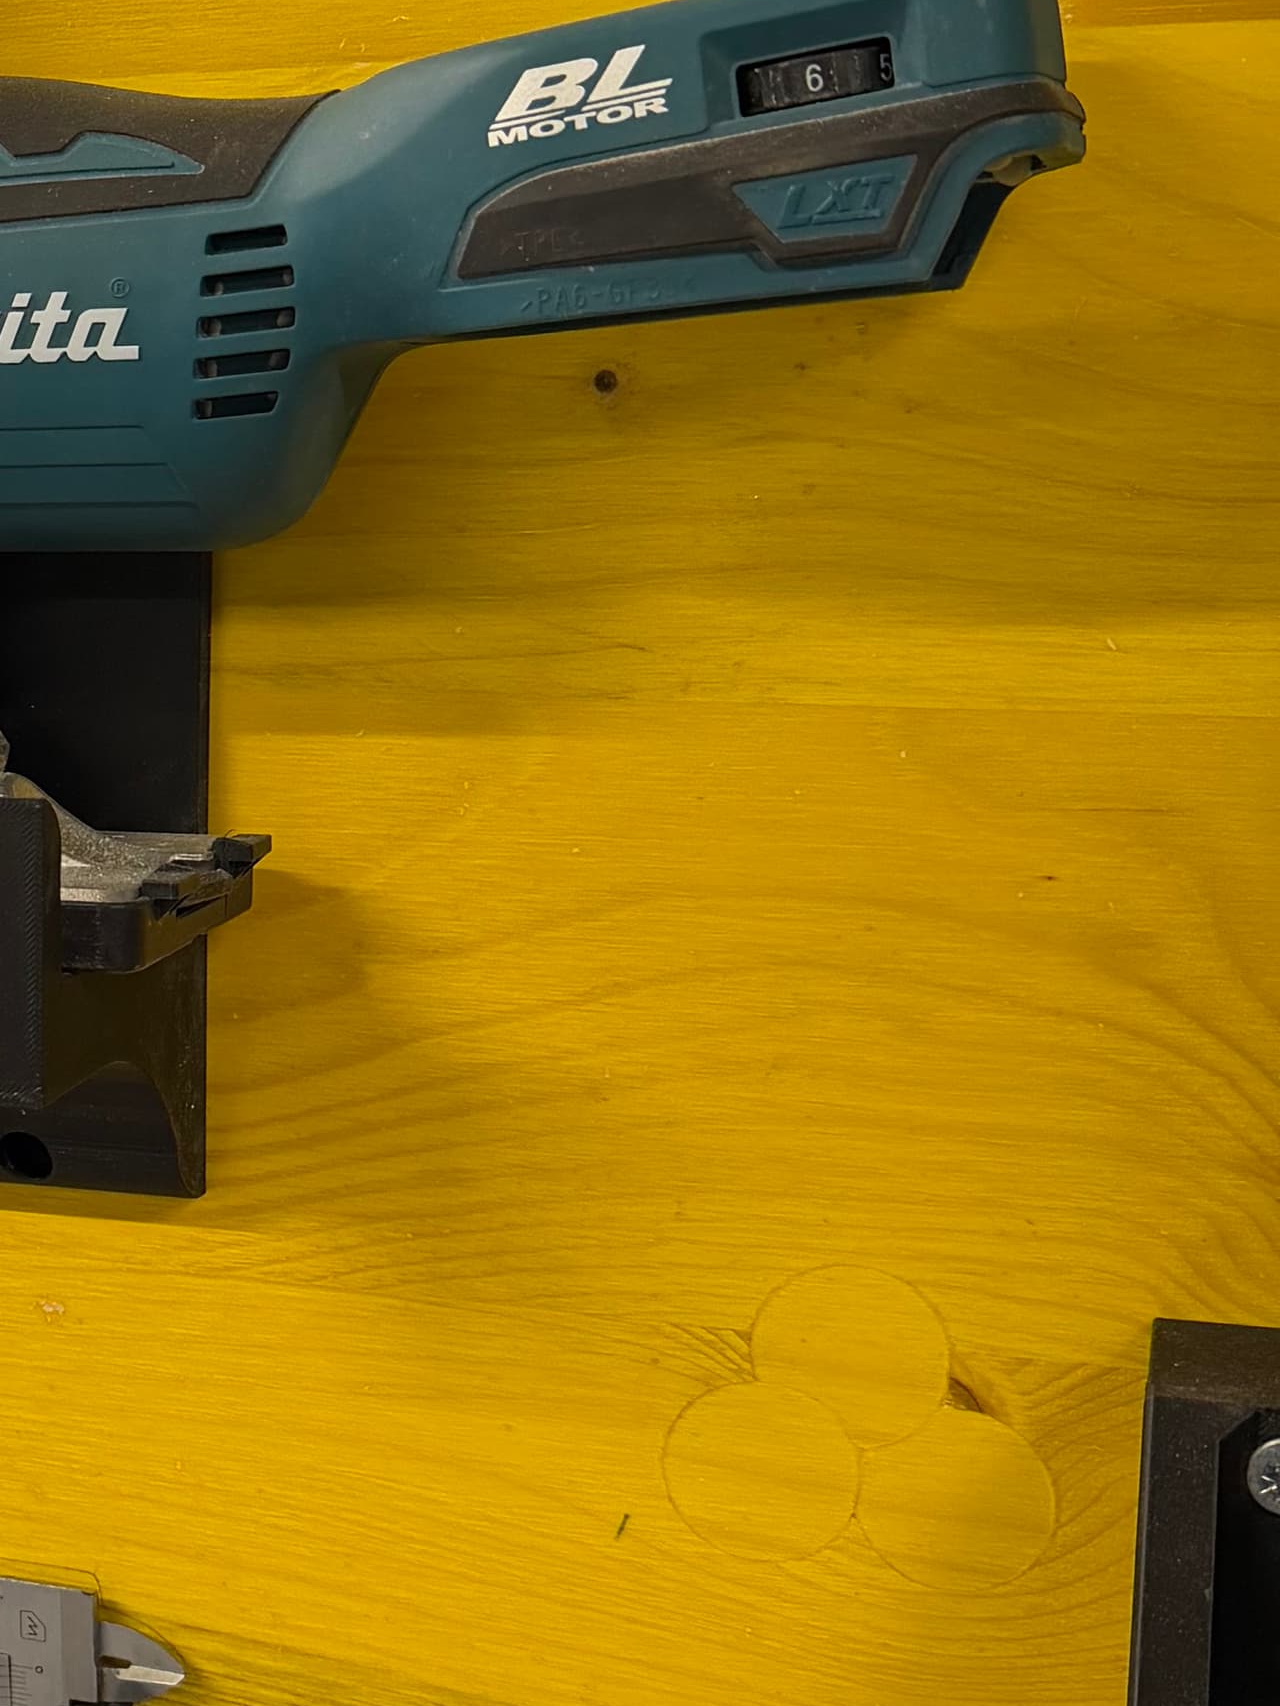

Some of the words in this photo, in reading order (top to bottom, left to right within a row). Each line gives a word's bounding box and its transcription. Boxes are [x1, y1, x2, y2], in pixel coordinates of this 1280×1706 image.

[495, 45, 673, 121] BL
[805, 64, 823, 92] 6
[878, 53, 893, 81] 5
[487, 97, 669, 148] MOTOR
[777, 173, 894, 230] LXT
